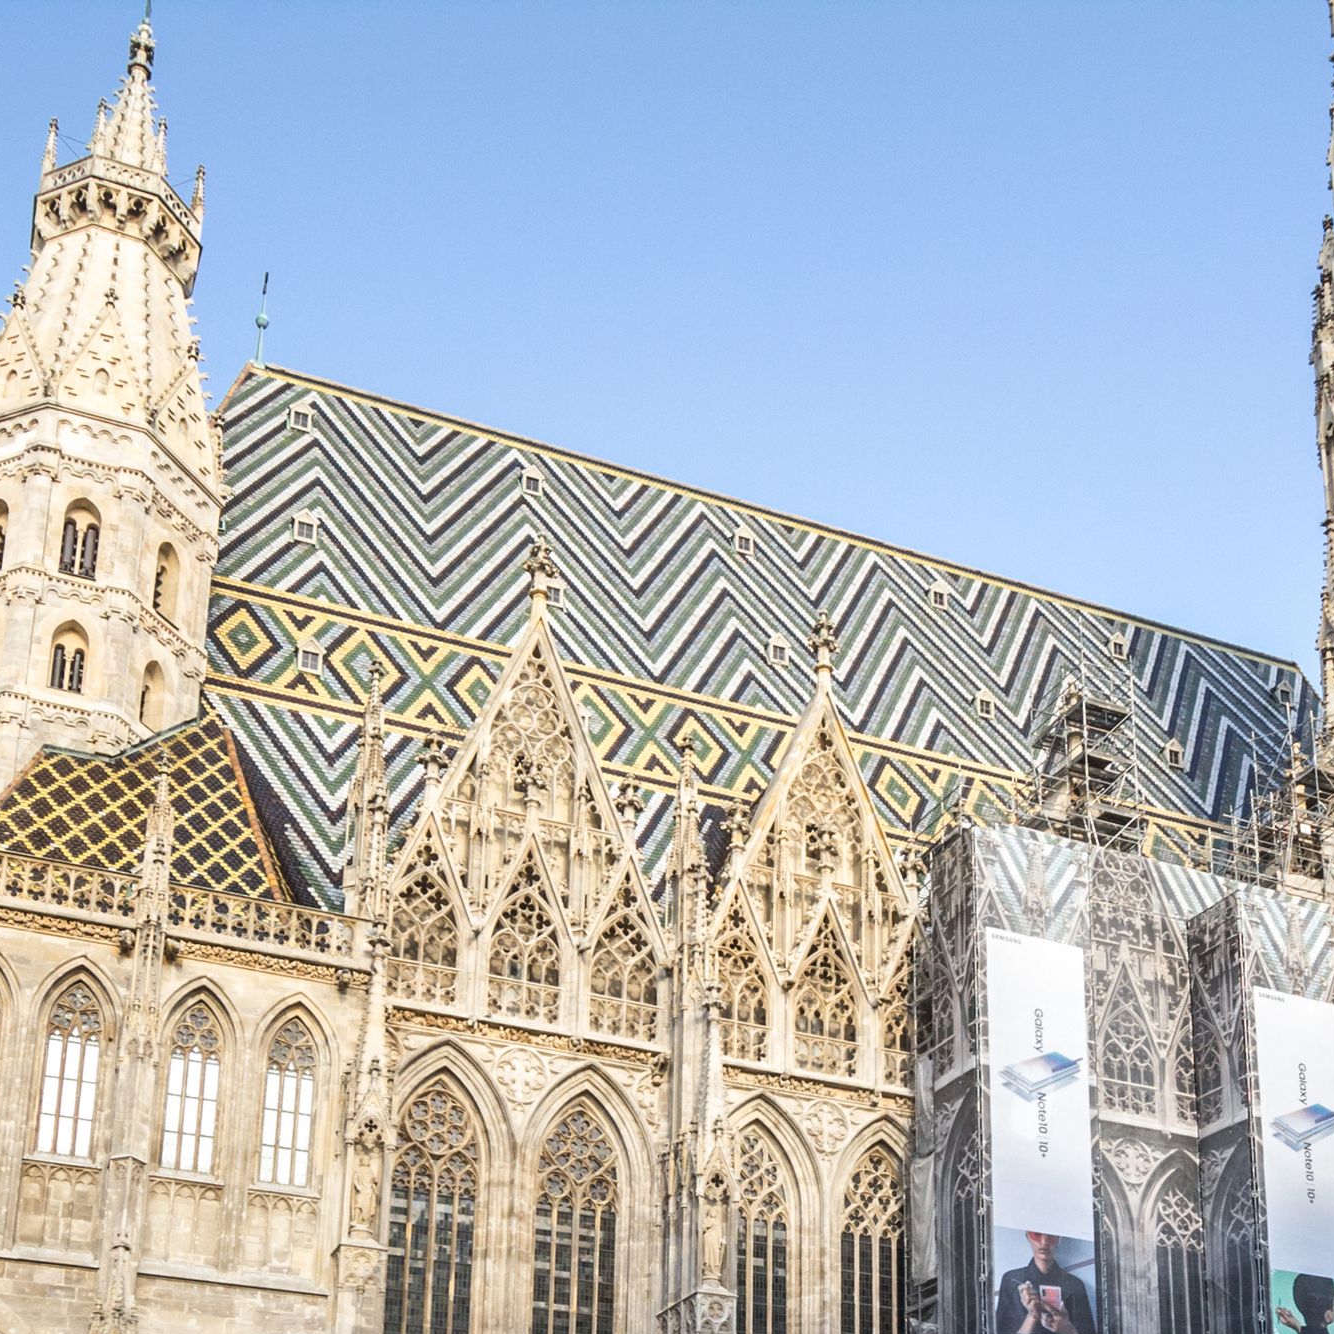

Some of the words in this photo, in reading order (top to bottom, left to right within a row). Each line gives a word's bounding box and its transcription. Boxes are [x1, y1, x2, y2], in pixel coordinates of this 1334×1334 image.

[991, 932, 1022, 945] SAMSUNG
[1034, 1008, 1043, 1053] Galaxy
[1037, 1091, 1048, 1134] Note10
[1298, 1063, 1307, 1105] Galaxy
[1303, 1142, 1315, 1182] Note10
[1039, 1141, 1049, 1158] 10+
